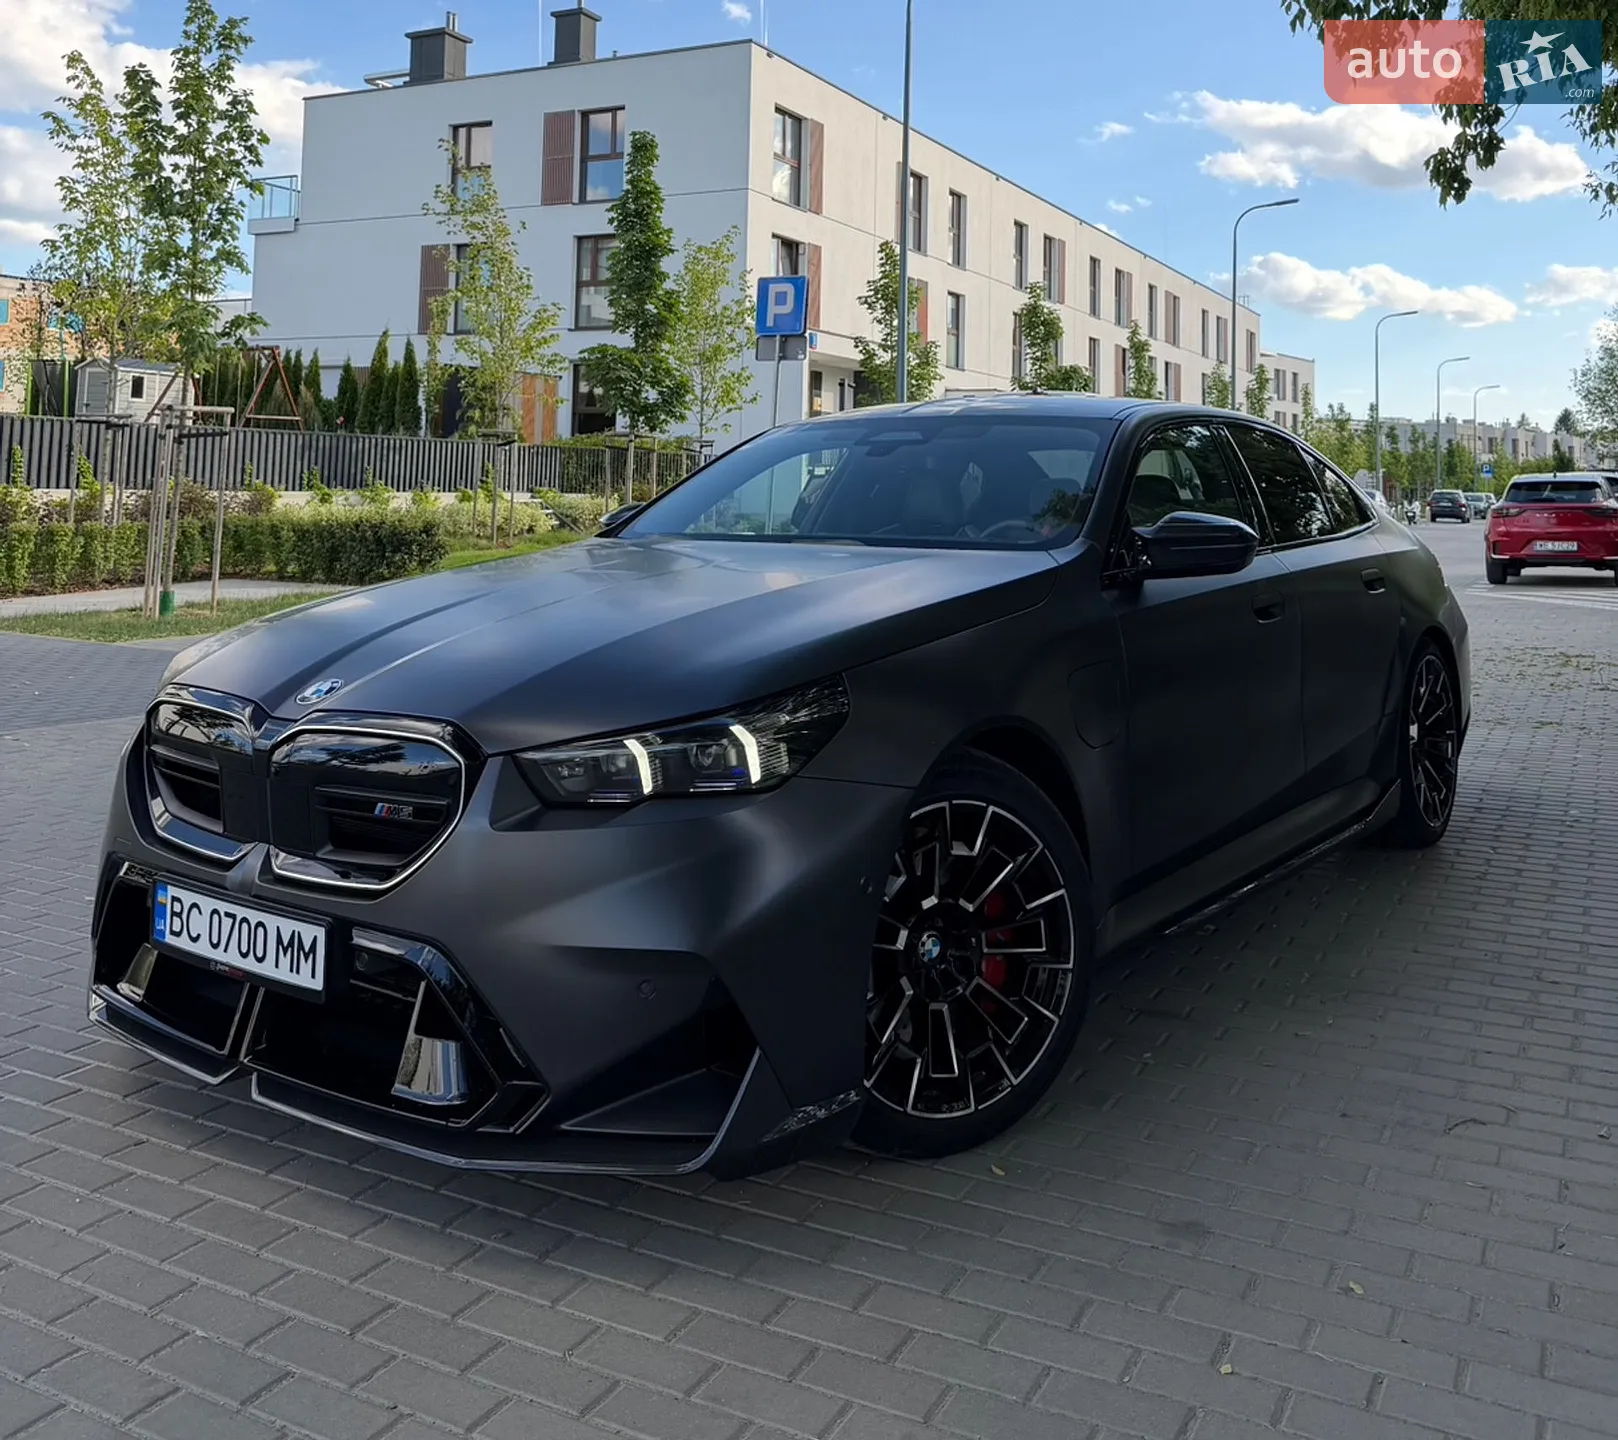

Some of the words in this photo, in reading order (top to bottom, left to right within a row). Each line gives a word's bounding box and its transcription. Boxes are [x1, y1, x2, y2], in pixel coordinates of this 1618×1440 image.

[766, 283, 795, 327] P
[169, 895, 202, 943] BC
[208, 908, 268, 964] 0700
[275, 925, 317, 979] MM
